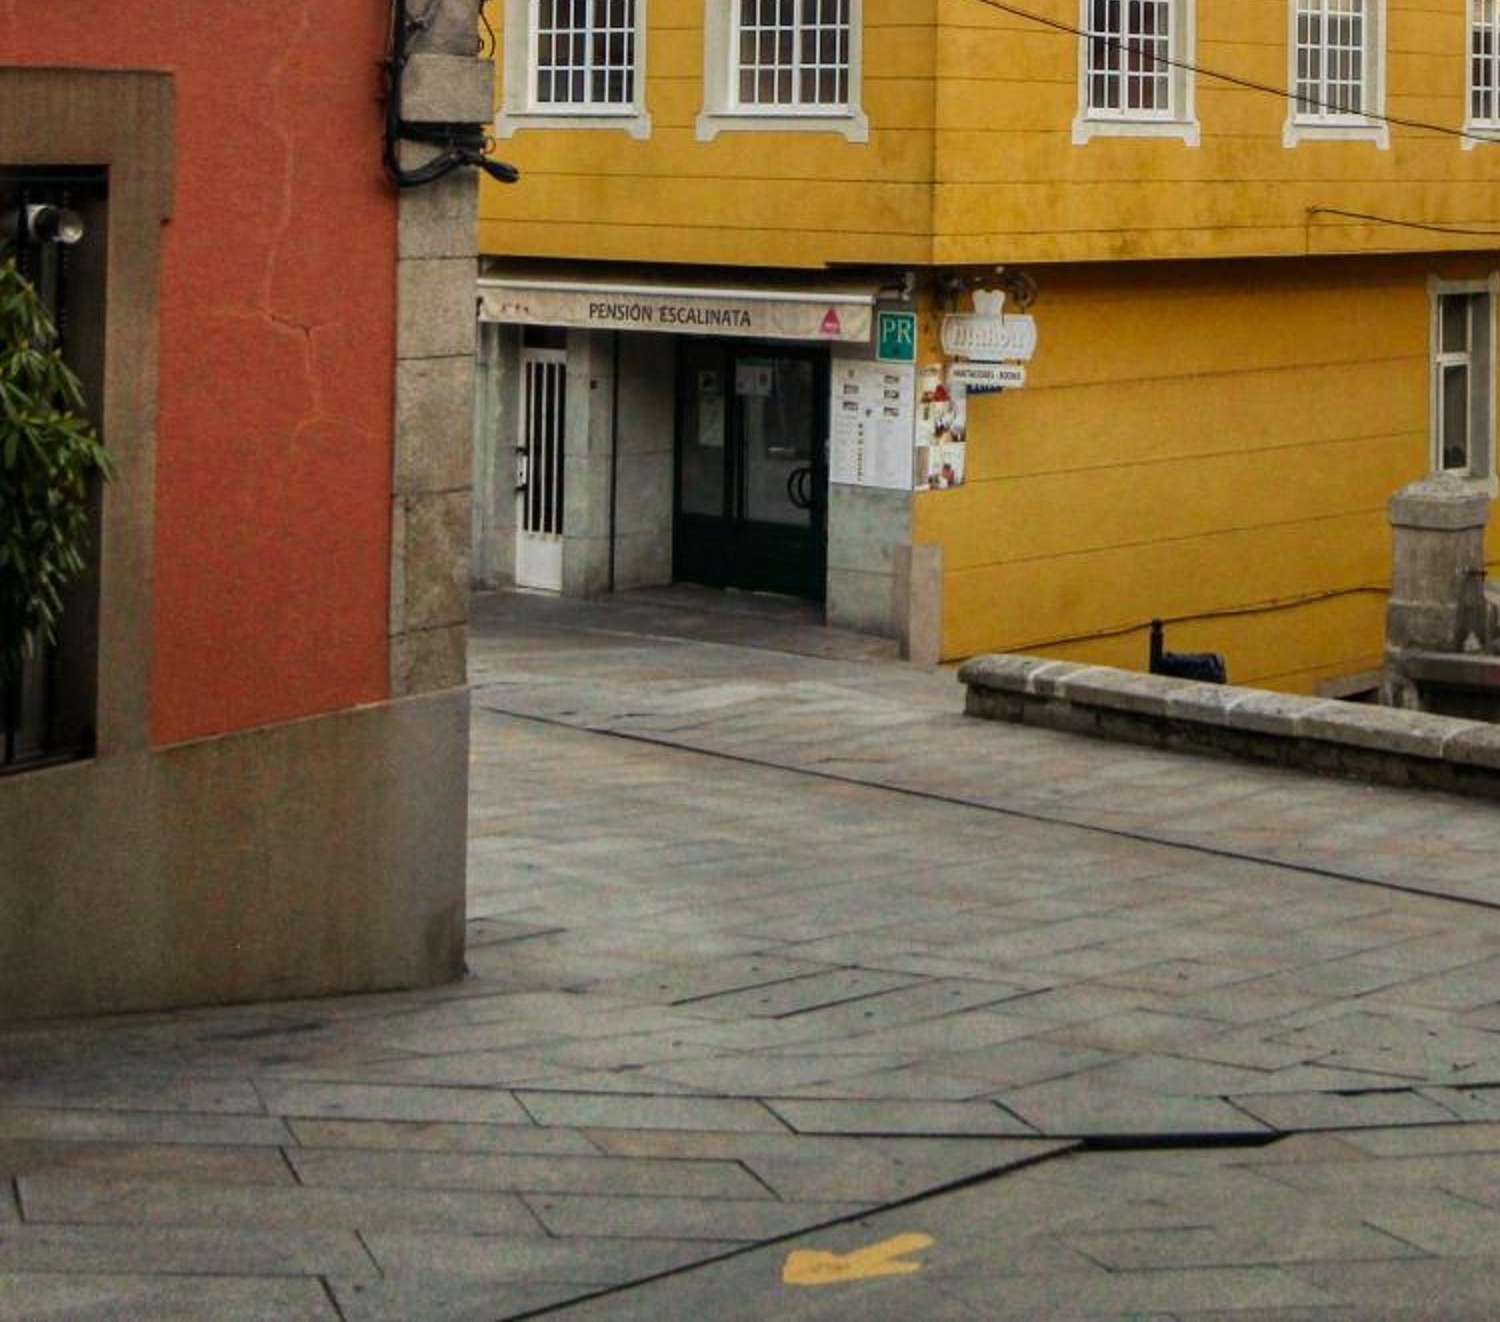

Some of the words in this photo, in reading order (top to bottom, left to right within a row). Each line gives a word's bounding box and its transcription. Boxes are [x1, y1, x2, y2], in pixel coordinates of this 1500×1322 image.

[589, 301, 653, 322] PENSIÓN
[659, 306, 751, 327] ESCALINATA
[882, 318, 912, 343] PR
